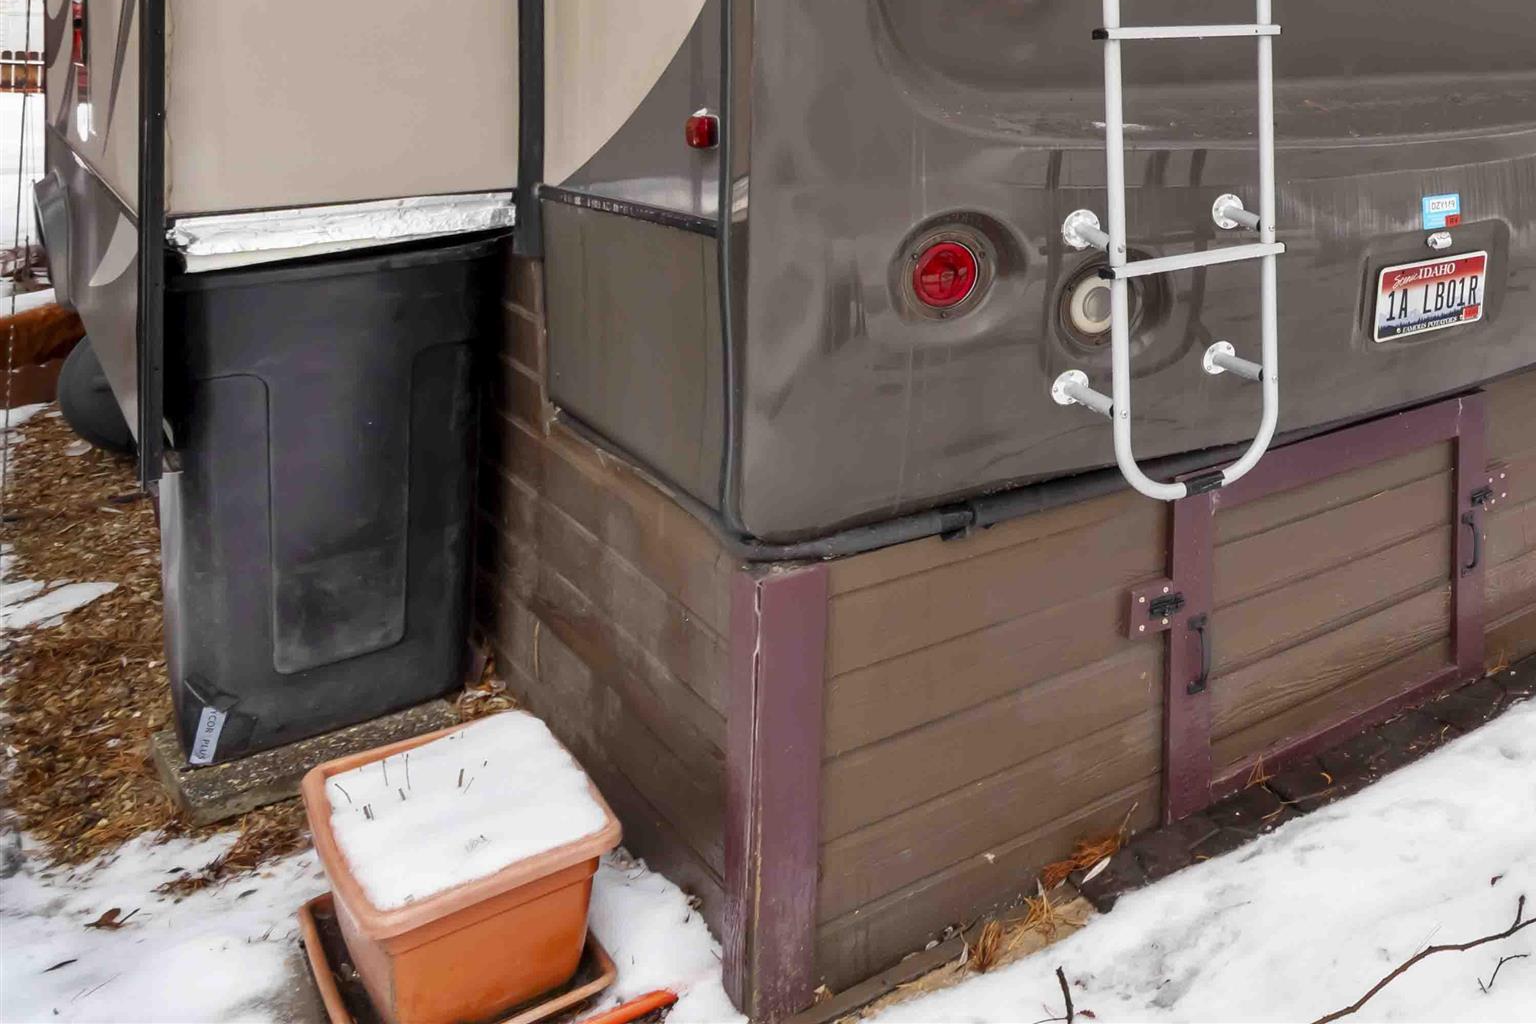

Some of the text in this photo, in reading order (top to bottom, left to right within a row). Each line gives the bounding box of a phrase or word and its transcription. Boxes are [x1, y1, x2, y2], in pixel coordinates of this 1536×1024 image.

[1392, 262, 1456, 290] Scenic IDAHO
[1386, 288, 1409, 322] 1A
[1402, 316, 1458, 334] FAMOUS POTATOES
